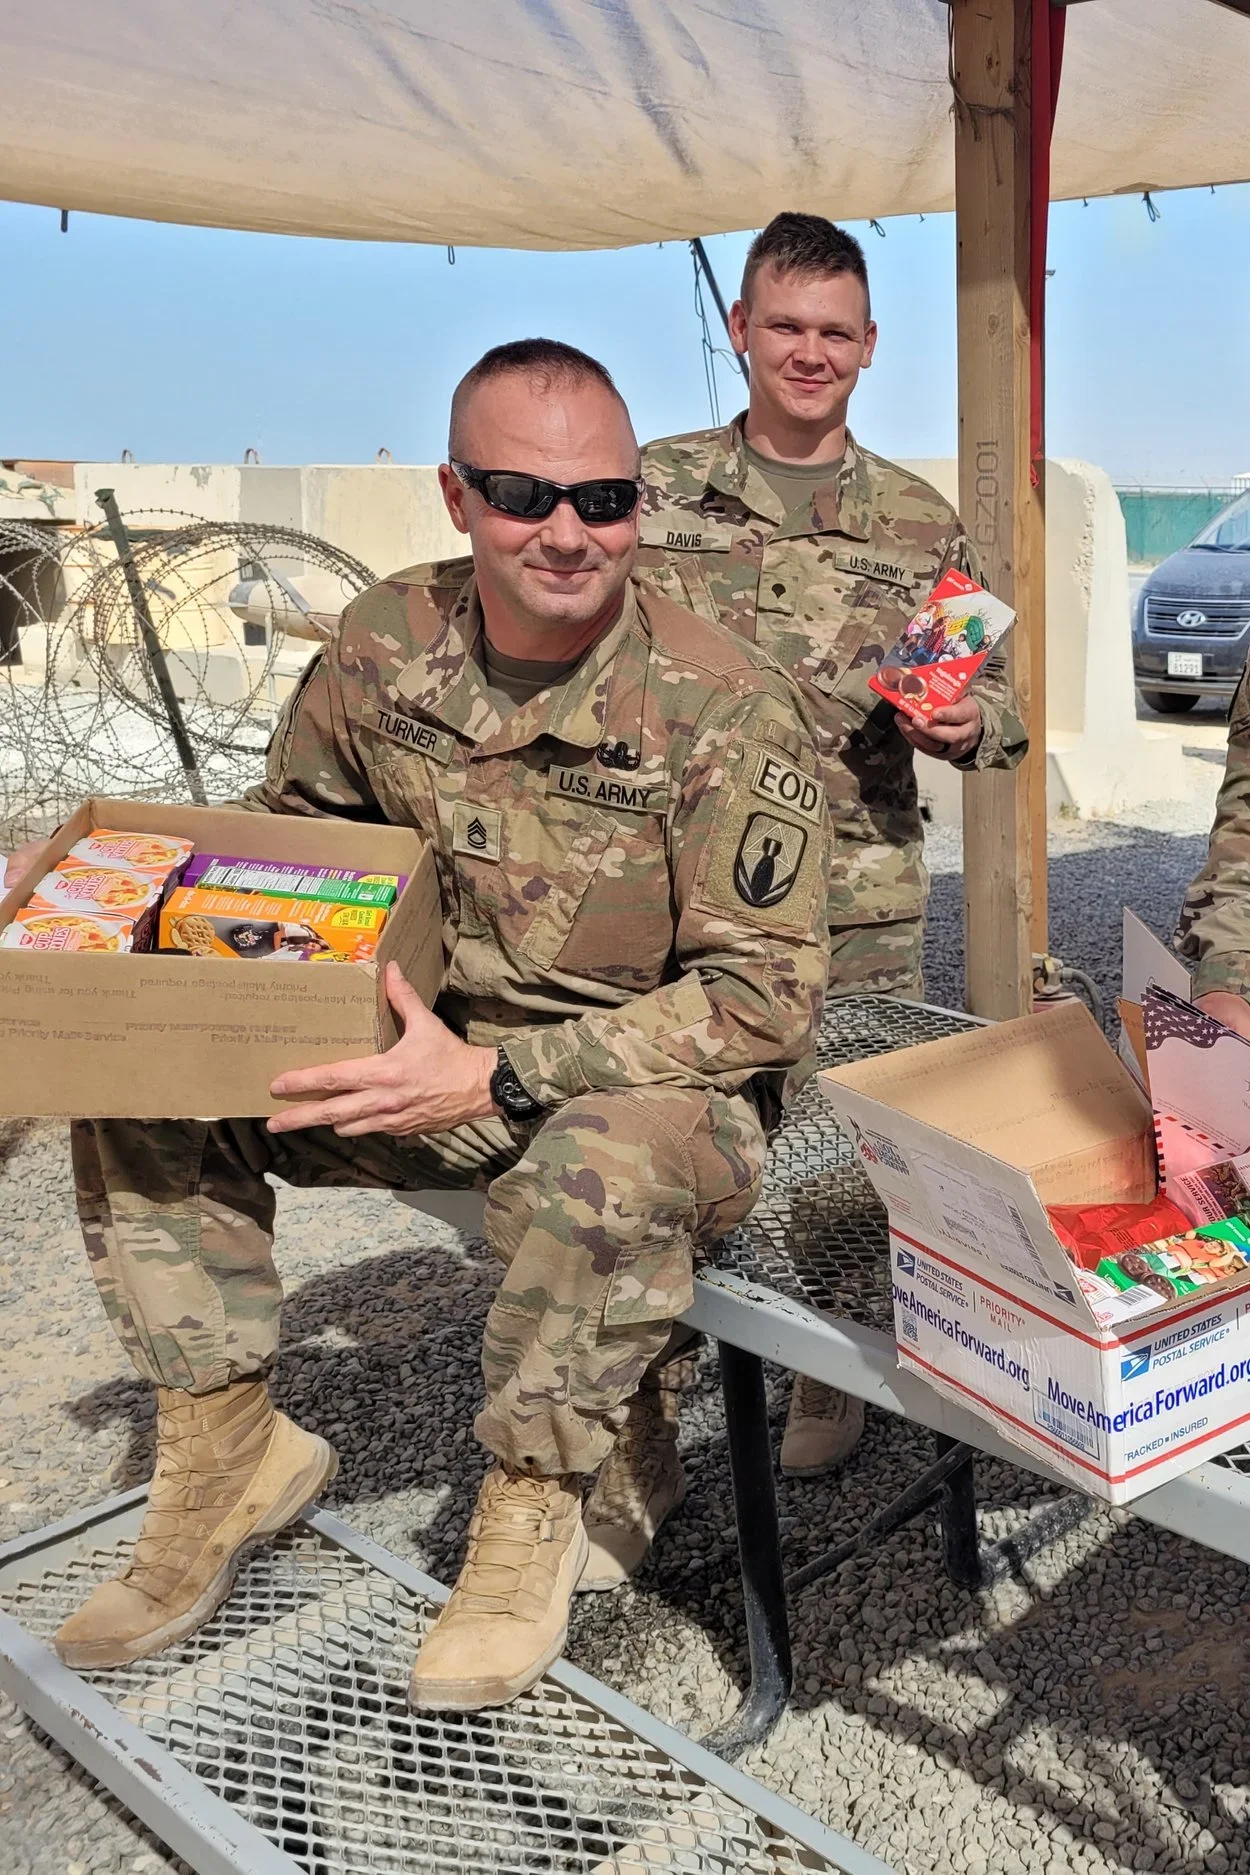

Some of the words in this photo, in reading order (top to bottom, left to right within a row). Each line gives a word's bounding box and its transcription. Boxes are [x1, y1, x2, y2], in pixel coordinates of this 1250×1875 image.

[666, 531, 702, 547] DAVIS
[849, 555, 872, 572] U.S.
[873, 562, 905, 580] ARMY
[376, 709, 438, 752] TURNER
[558, 770, 591, 796] U.S.
[594, 775, 652, 808] ARMY
[756, 759, 819, 813] EOD
[77, 987, 97, 997] you
[268, 982, 308, 993] Priority
[1180, 1176, 1206, 1206] SERVICE
[916, 1258, 941, 1278] UNITED
[941, 1272, 964, 1291] STATES
[916, 1273, 938, 1293] POSTAL
[892, 1282, 1031, 1391] oveAmericaForward.org
[990, 1315, 1012, 1333] MAIL
[1154, 1328, 1190, 1353] UNITED
[1189, 1313, 1223, 1337] STATES
[1152, 1344, 1188, 1370] POSTAL
[1171, 1416, 1209, 1442] INSURED
